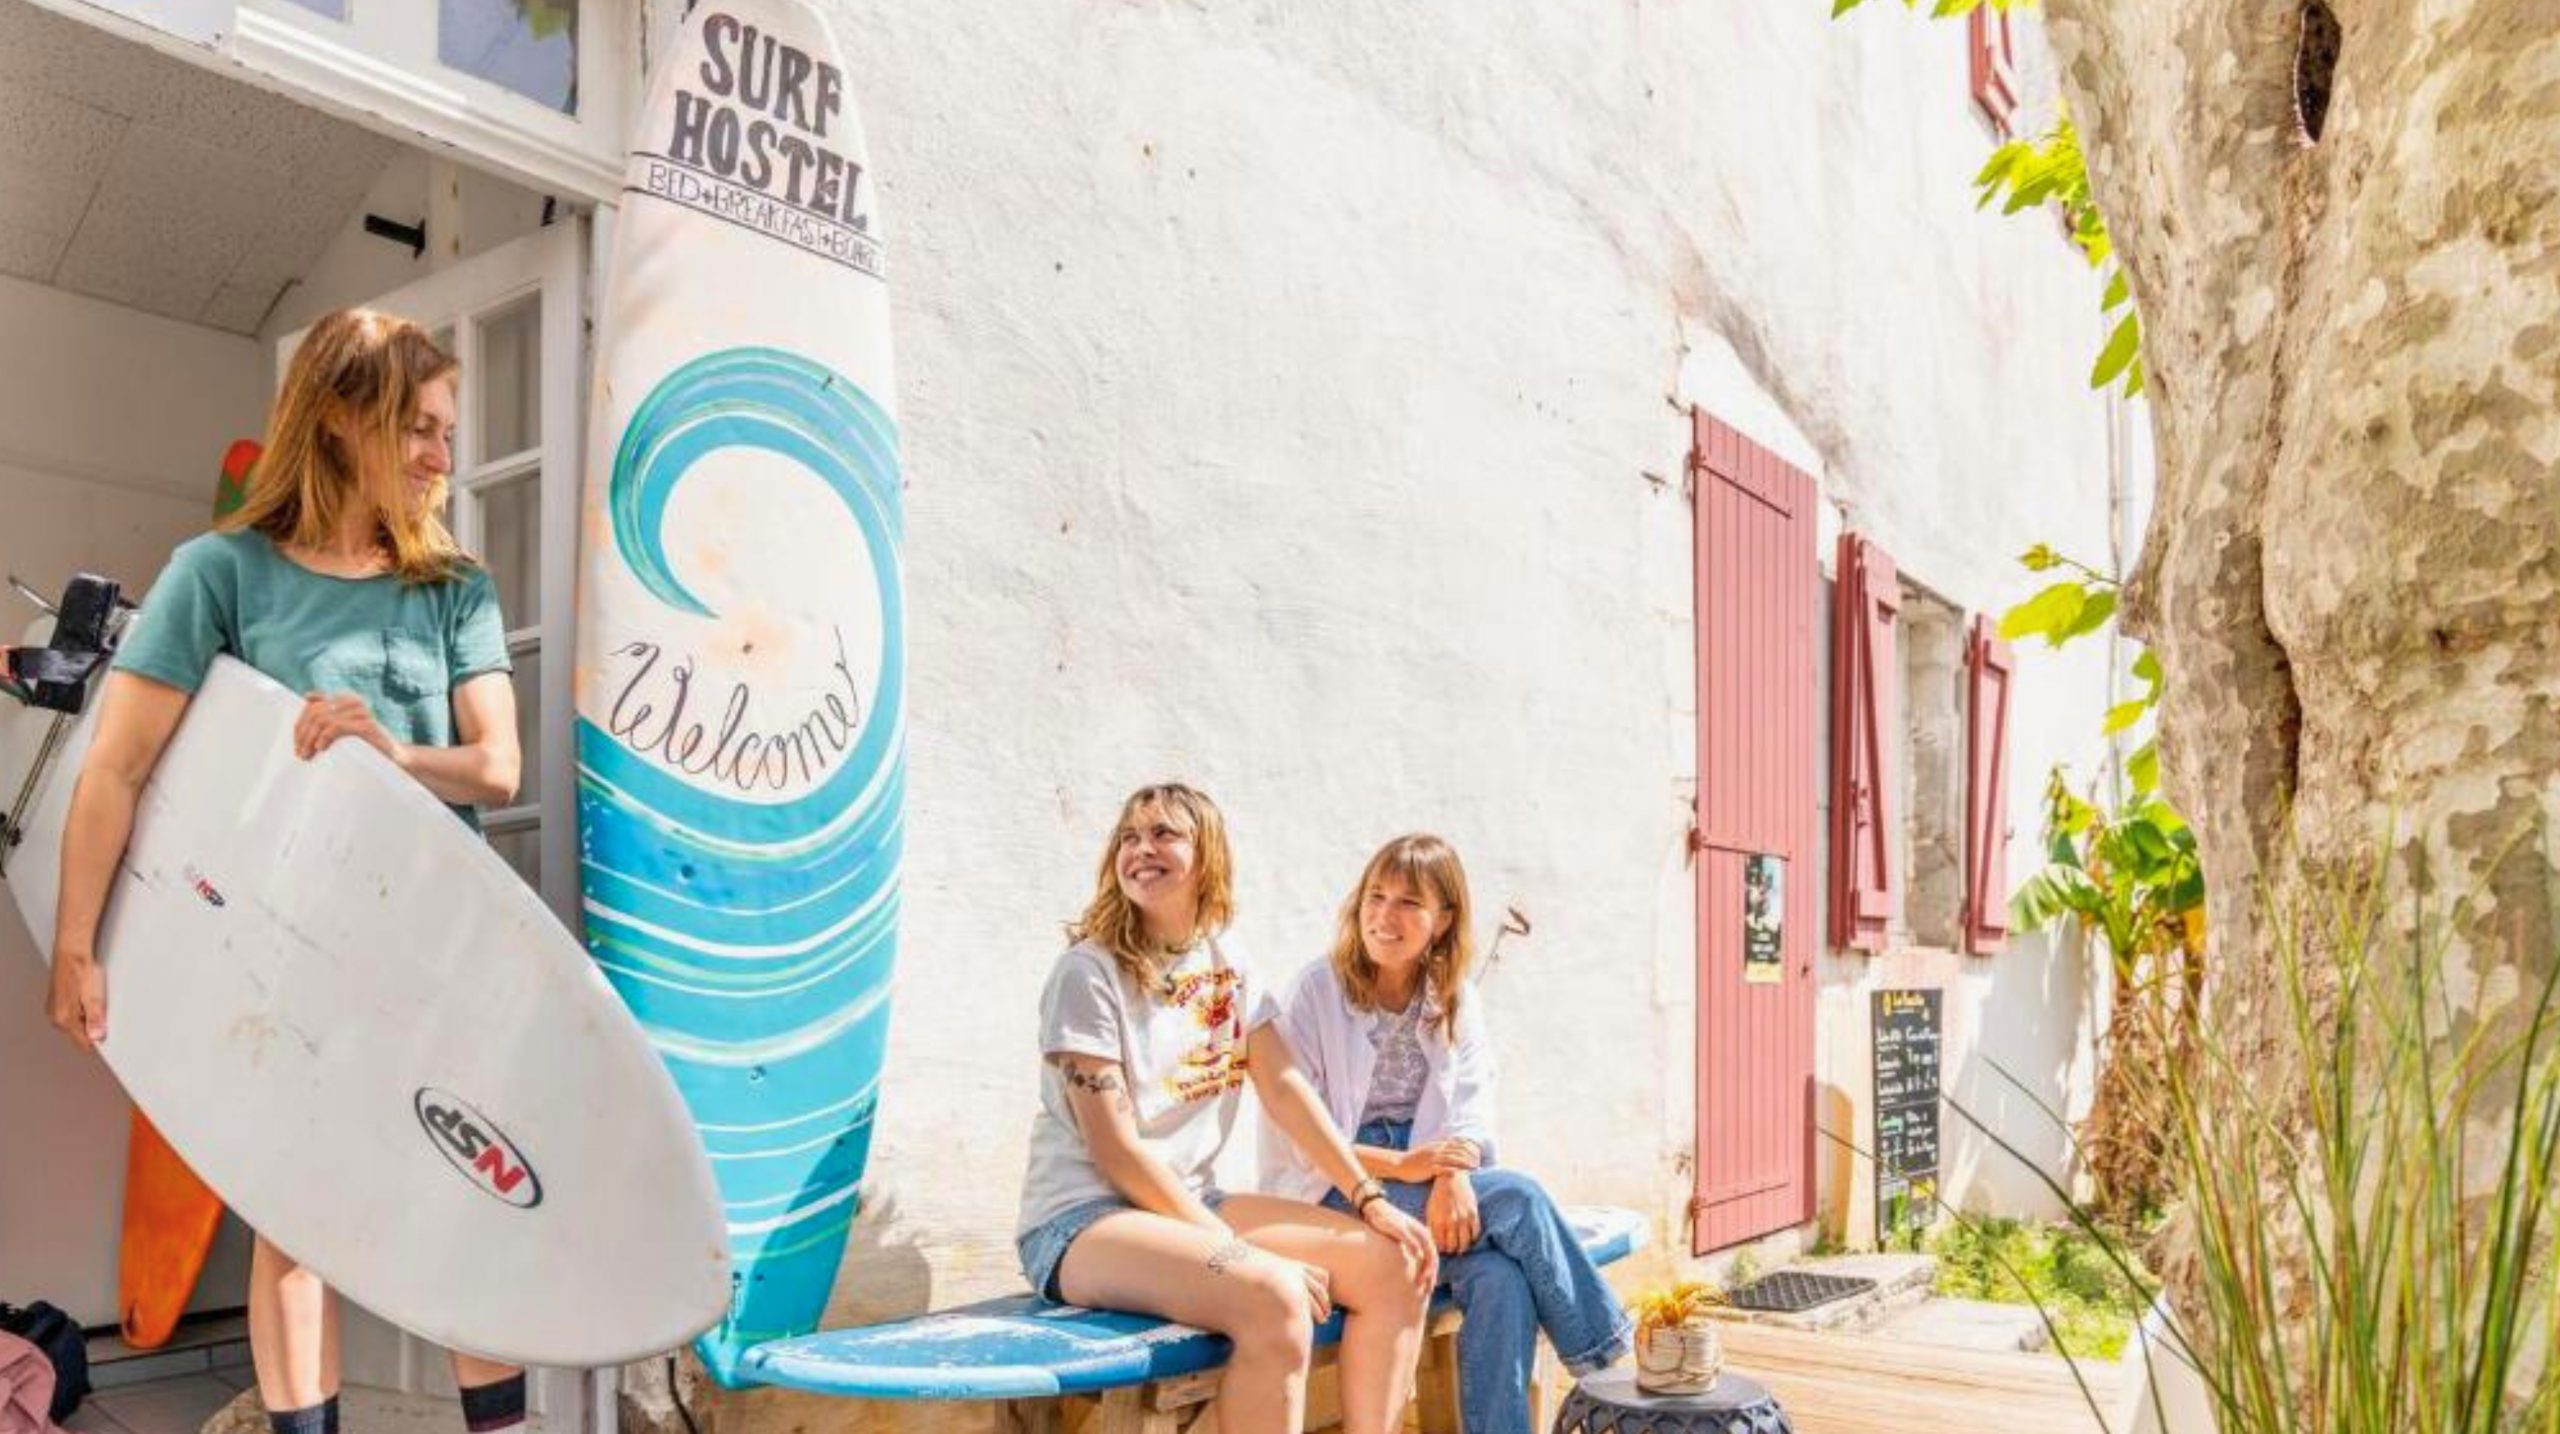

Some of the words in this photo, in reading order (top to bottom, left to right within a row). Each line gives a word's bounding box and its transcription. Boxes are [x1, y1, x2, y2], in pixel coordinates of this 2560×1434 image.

[700, 13, 841, 138] SURF
[668, 90, 867, 231] HOSTEL
[607, 625, 859, 790] Welcome
[425, 1104, 526, 1193] NSP
